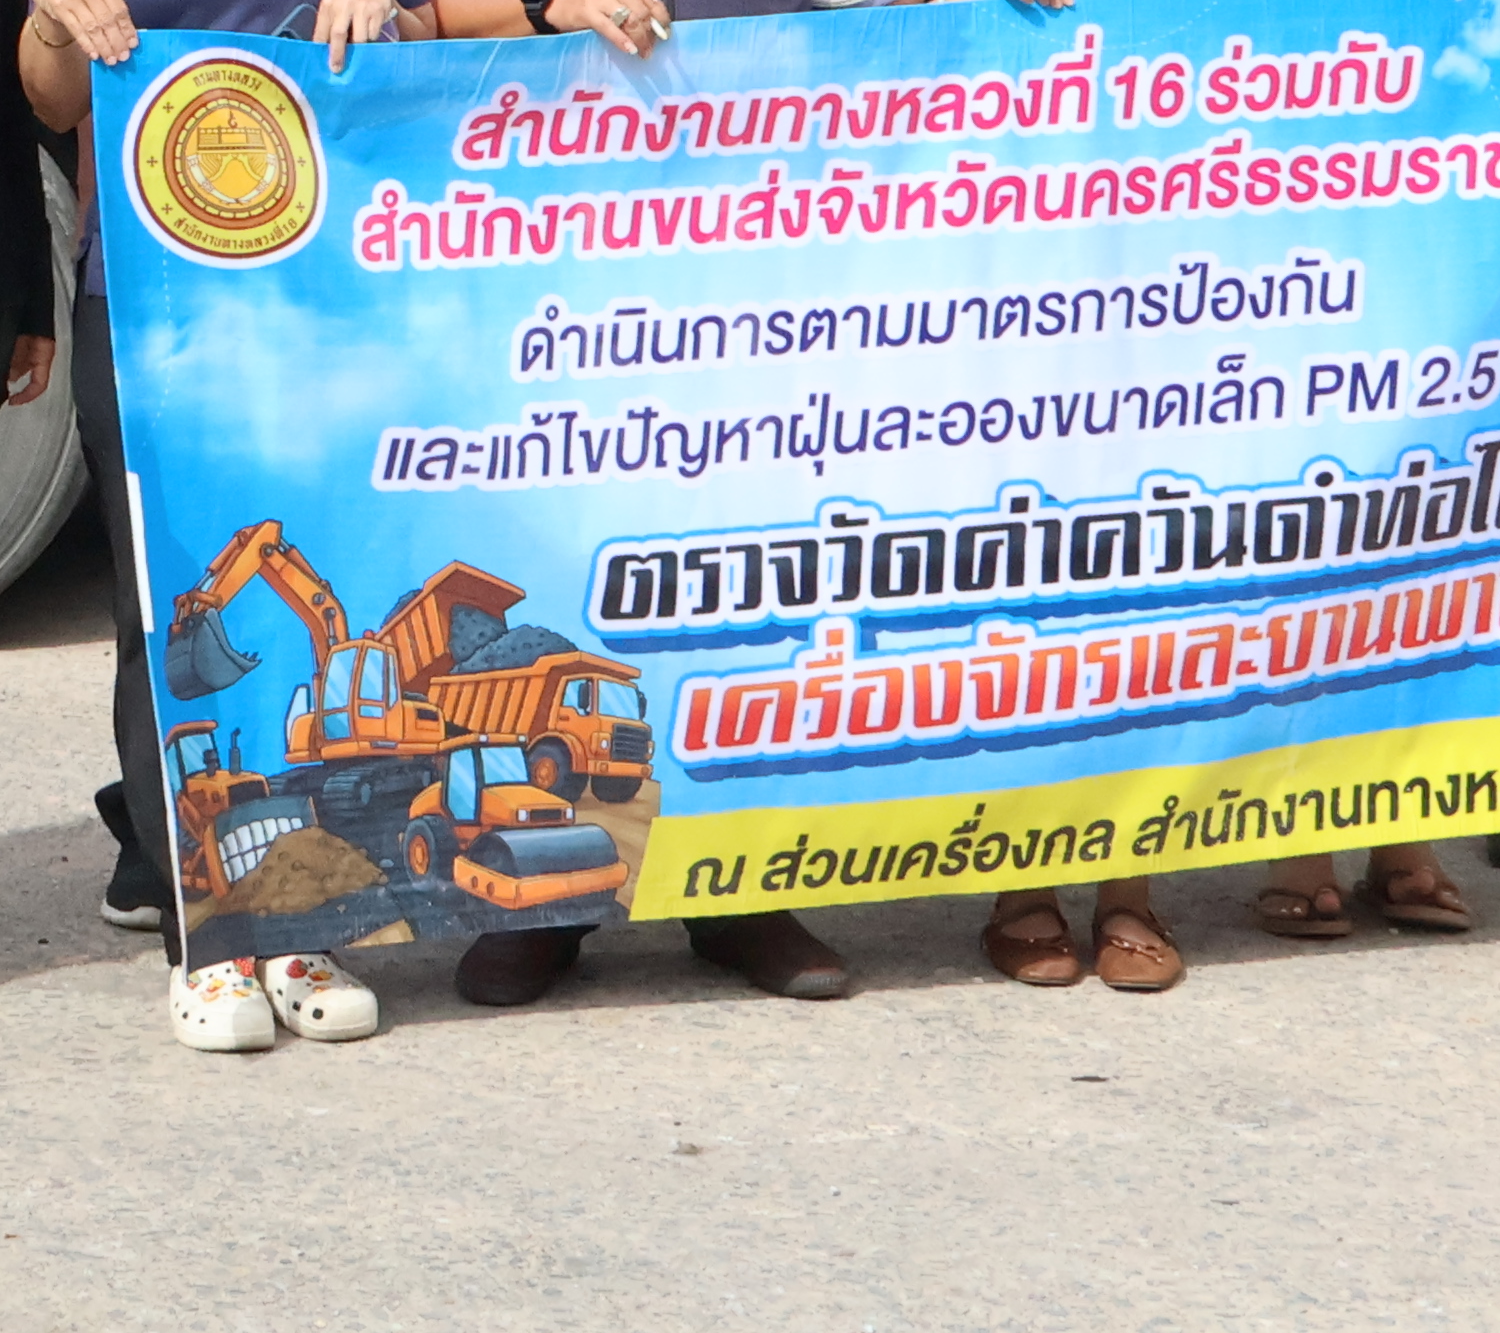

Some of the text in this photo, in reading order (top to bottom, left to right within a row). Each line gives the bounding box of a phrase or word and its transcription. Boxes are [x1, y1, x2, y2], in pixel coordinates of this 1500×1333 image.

[460, 32, 1415, 162] สำนักงานทางหลวงที่ 16 ร่วมกับ
[519, 256, 1356, 373] ดำเนินการตามมาตรการป้องกัน
[382, 349, 1500, 481] และแก้ไขปัญหาฝุ่นละอองขนาดเล็ก PM 2.5
[682, 854, 747, 899] ณ
[759, 802, 1116, 892] ส่วนเครื่องกล
